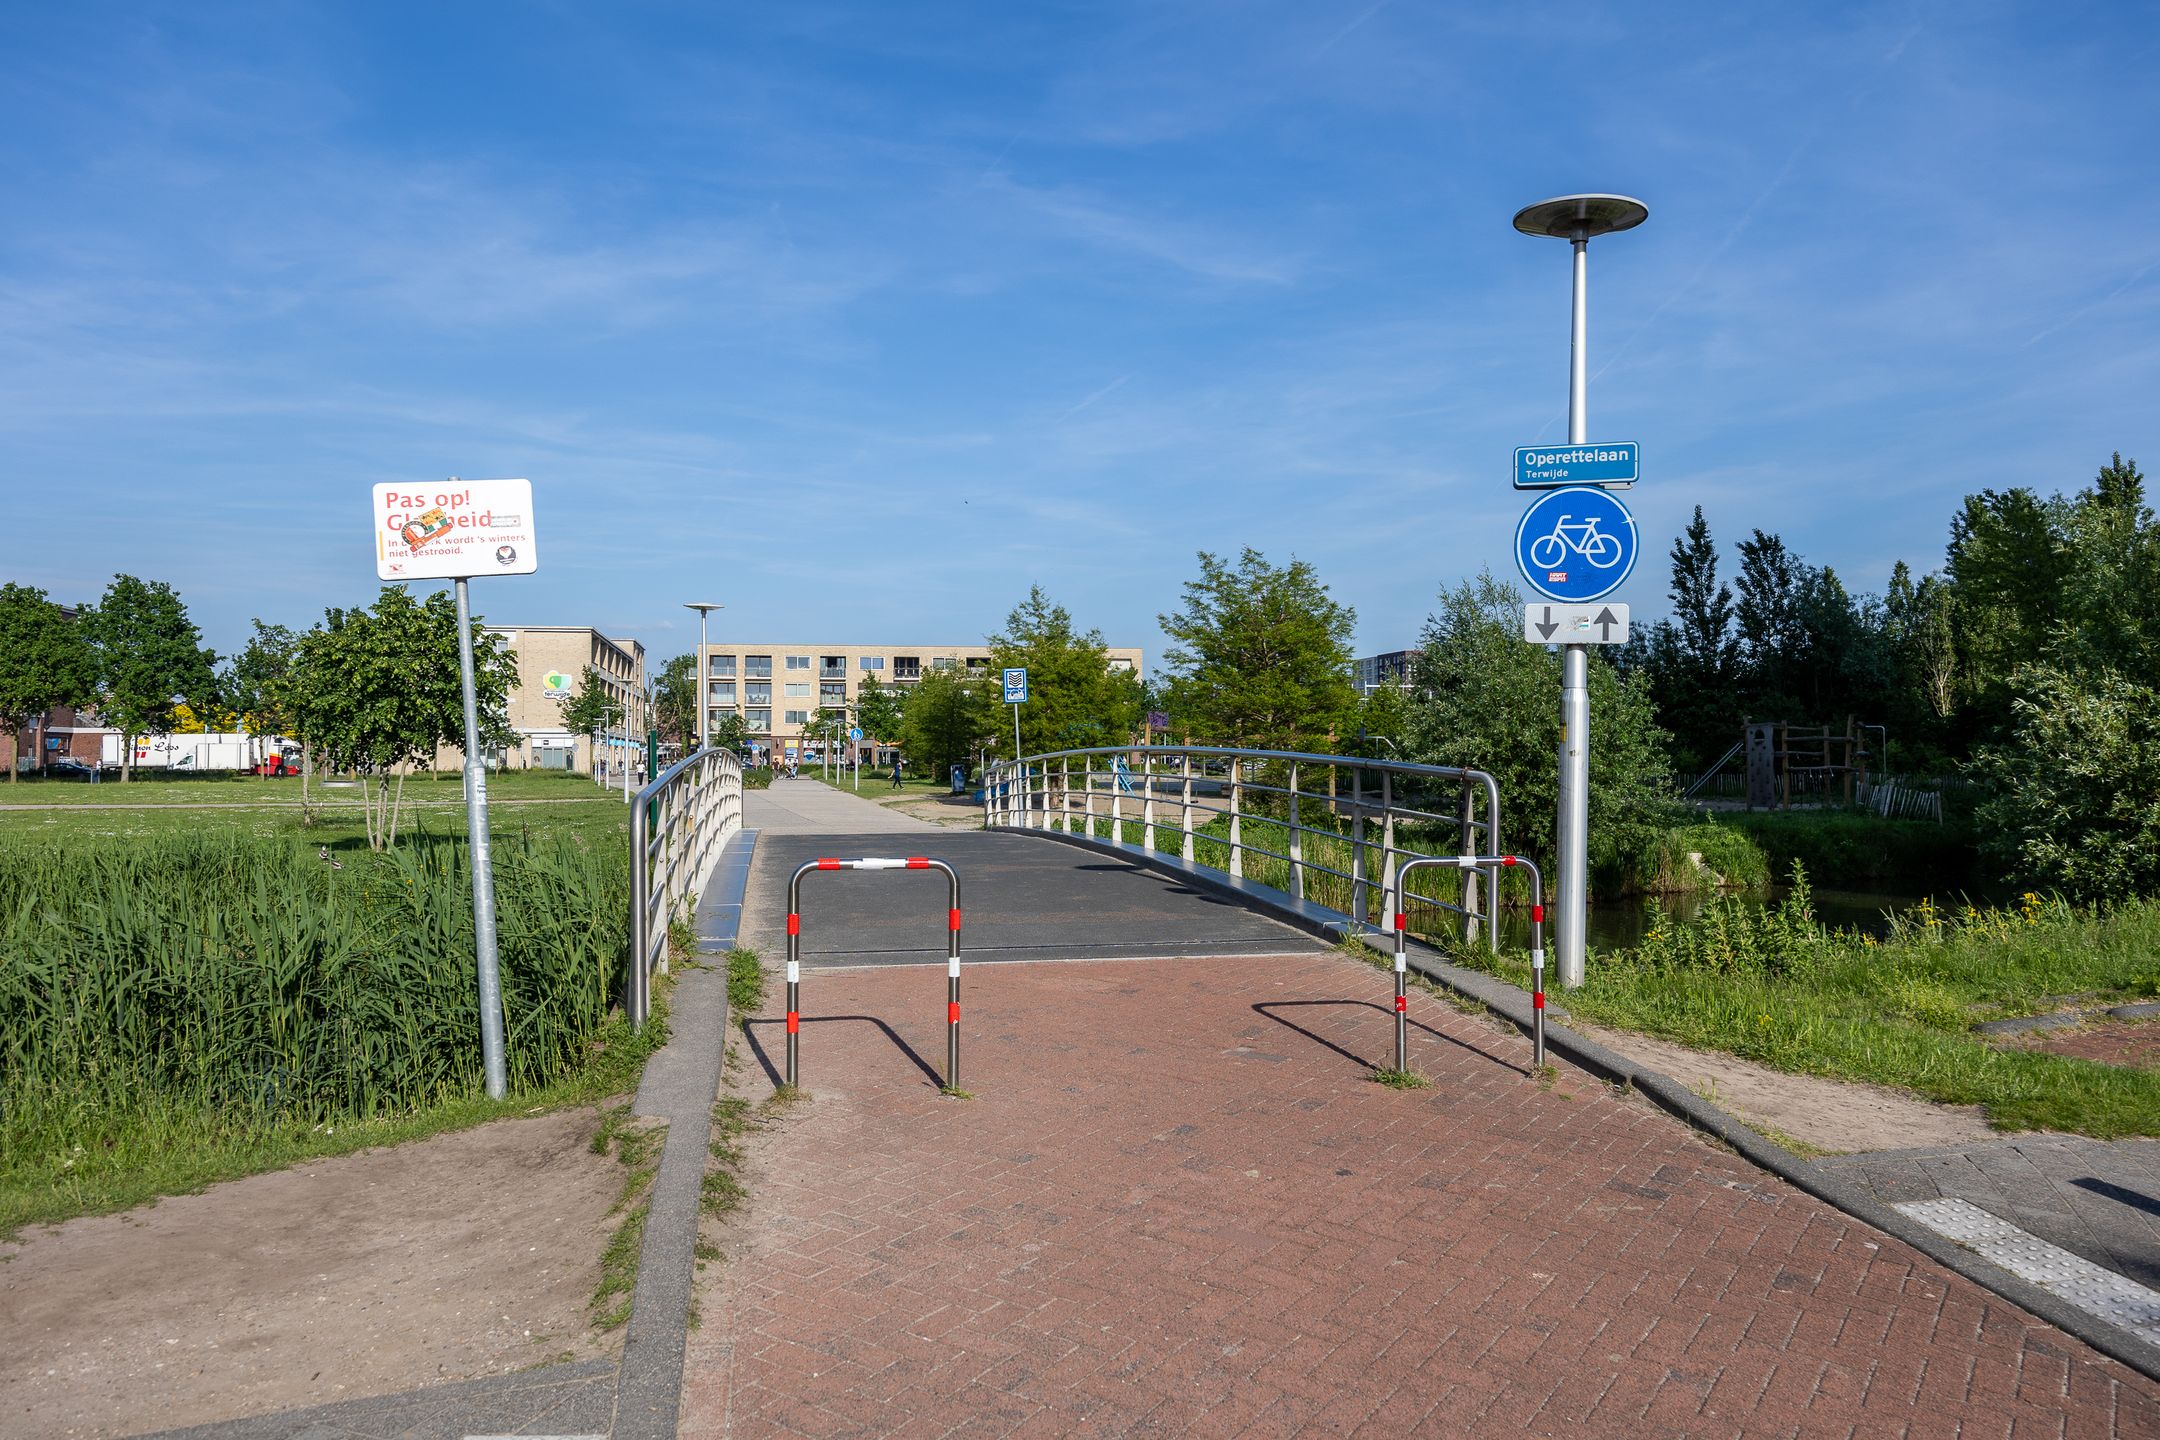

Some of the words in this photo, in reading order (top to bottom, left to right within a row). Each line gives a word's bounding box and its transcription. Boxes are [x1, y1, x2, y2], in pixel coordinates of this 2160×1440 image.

[1525, 449, 1629, 467] Operettelaan
[1526, 469, 1569, 479] Terwijde
[386, 492, 426, 508] Pas
[435, 489, 469, 509] op!
[389, 539, 398, 547] In
[445, 536, 474, 544] wordt
[489, 534, 526, 543] winters
[389, 549, 408, 558] niet
